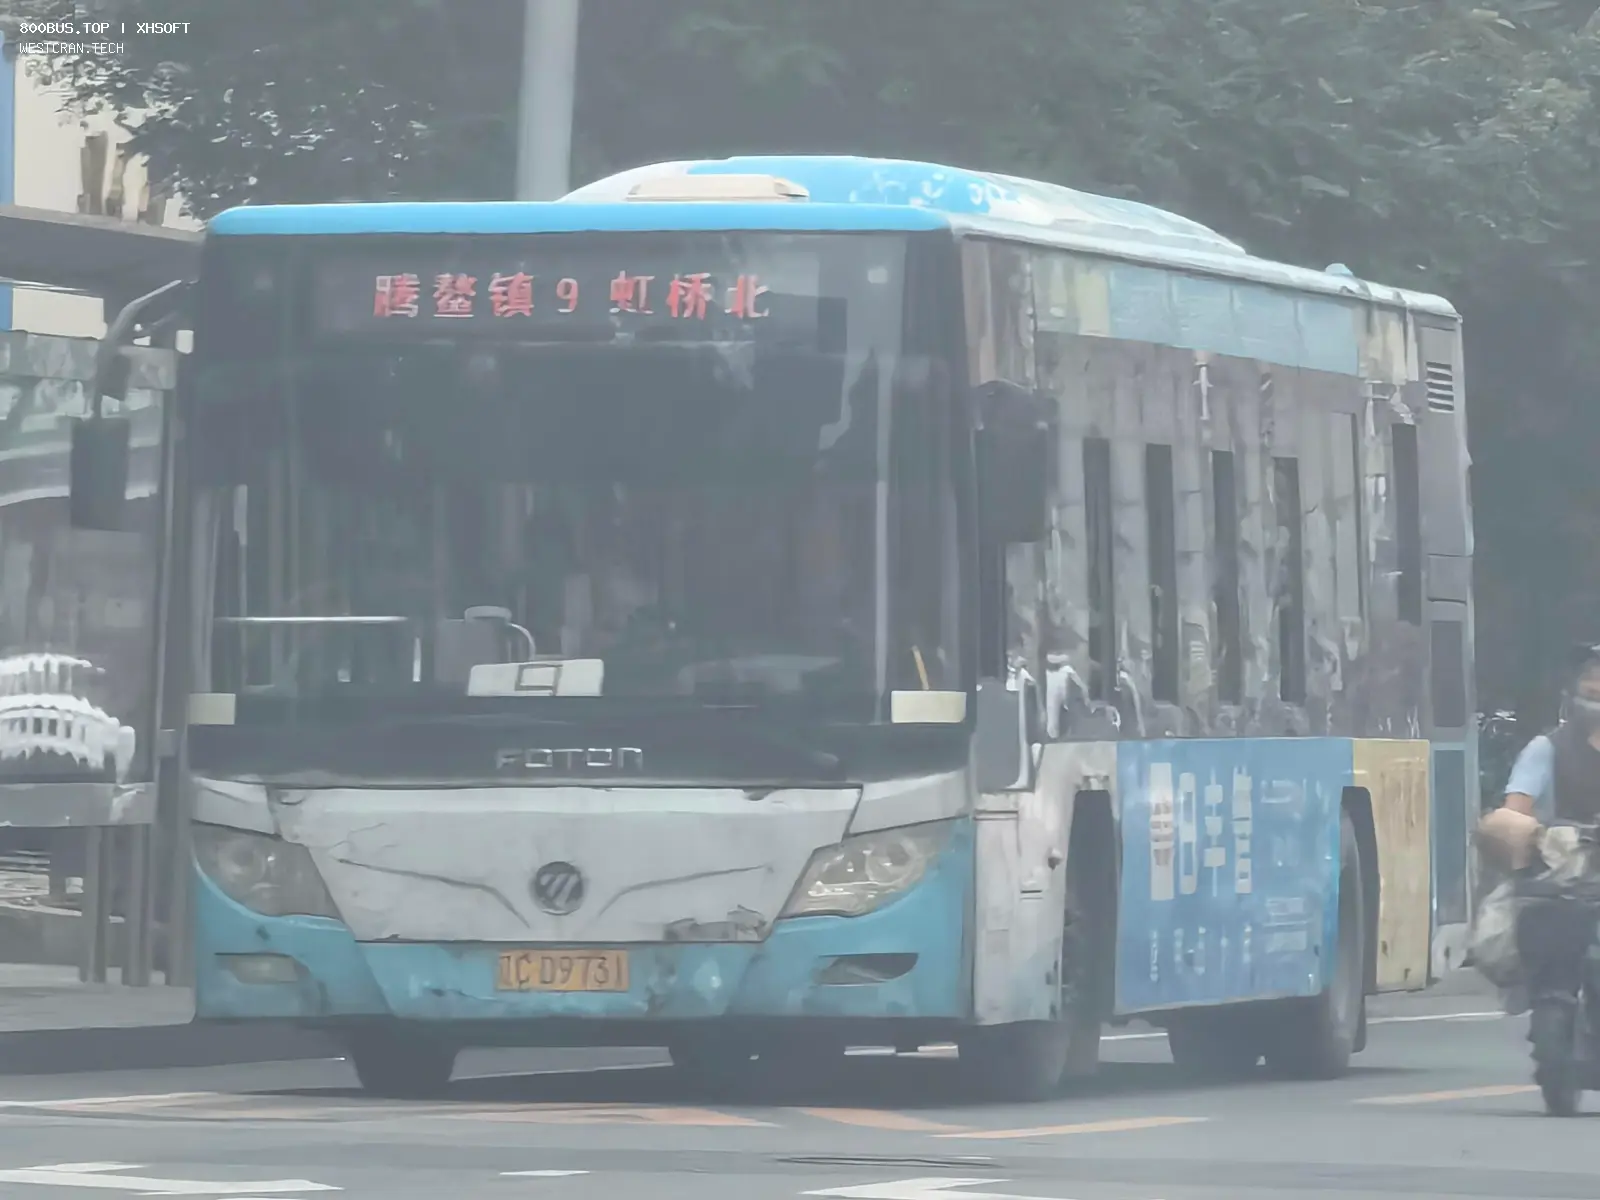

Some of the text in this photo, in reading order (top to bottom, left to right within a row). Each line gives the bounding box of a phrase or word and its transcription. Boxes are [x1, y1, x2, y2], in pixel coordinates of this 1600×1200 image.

[556, 278, 579, 314] 9
[609, 271, 770, 319] 虹桥北
[495, 747, 643, 770] FOTON
